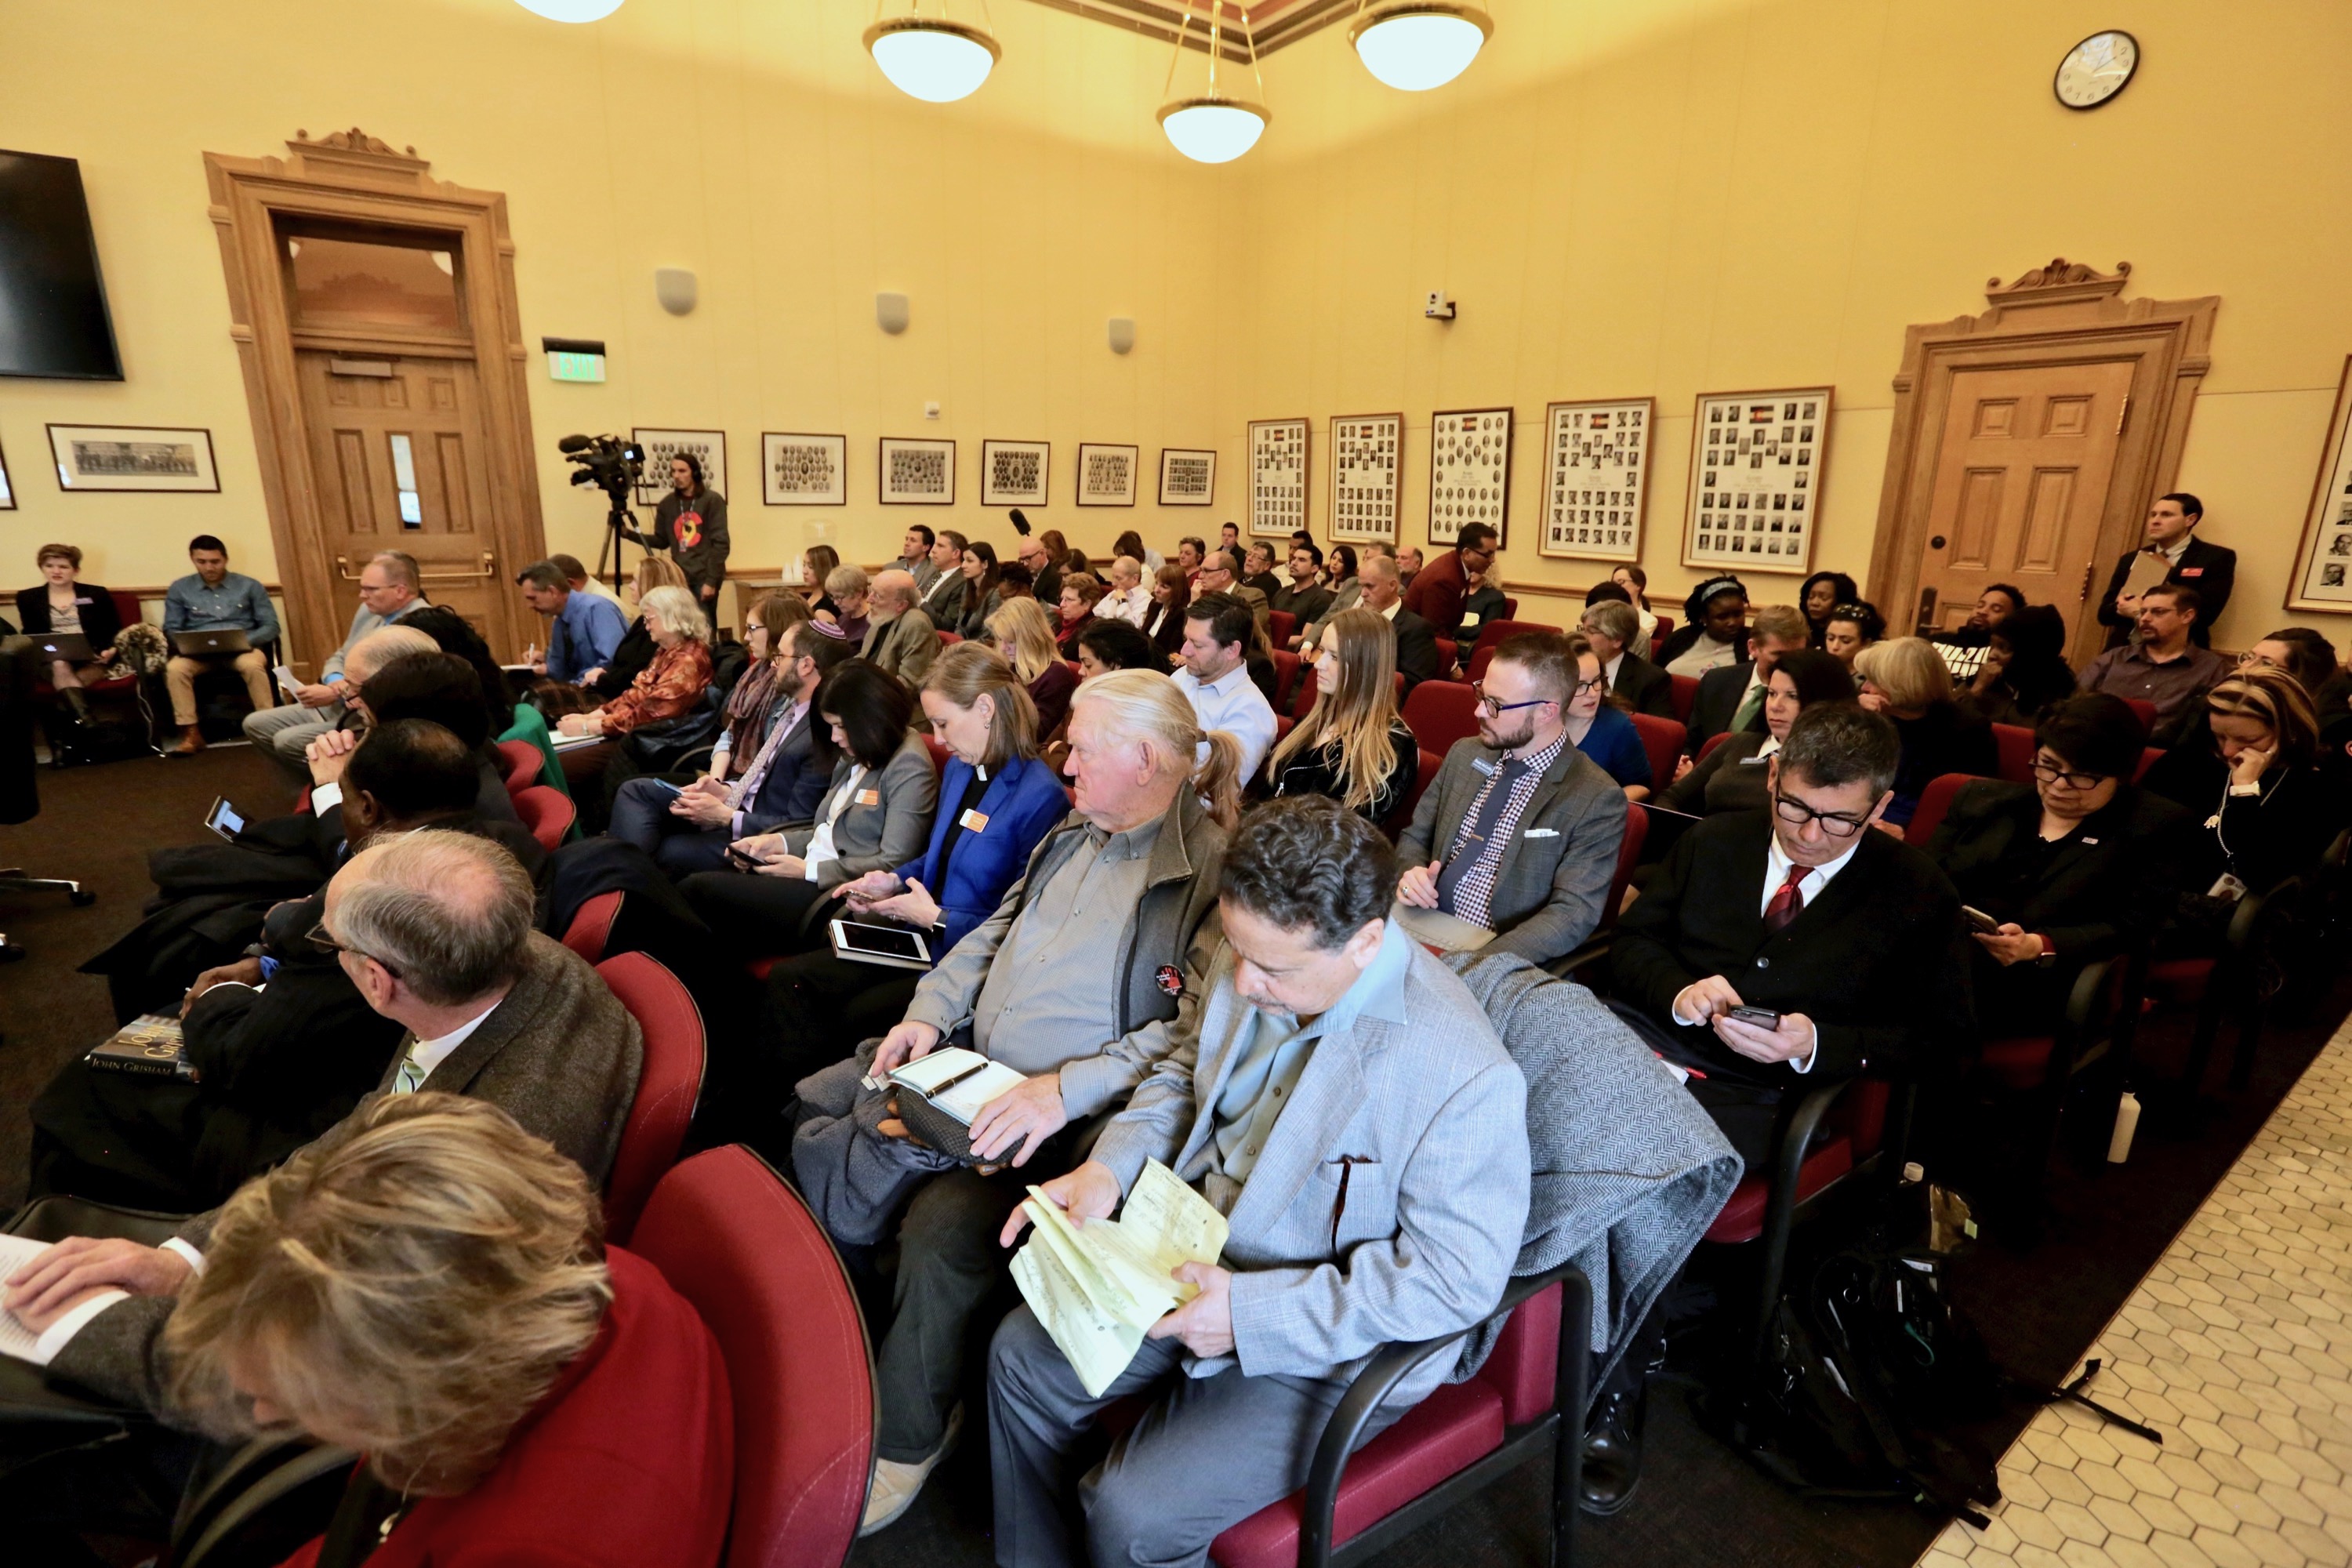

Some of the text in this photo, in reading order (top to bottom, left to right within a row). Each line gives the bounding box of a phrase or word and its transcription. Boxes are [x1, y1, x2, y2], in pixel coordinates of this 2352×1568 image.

[559, 352, 596, 379] EXIT
[118, 1025, 167, 1047] JOHN
[144, 1036, 184, 1058] GRIS
[93, 1058, 171, 1076] JOHN GRISHAM
